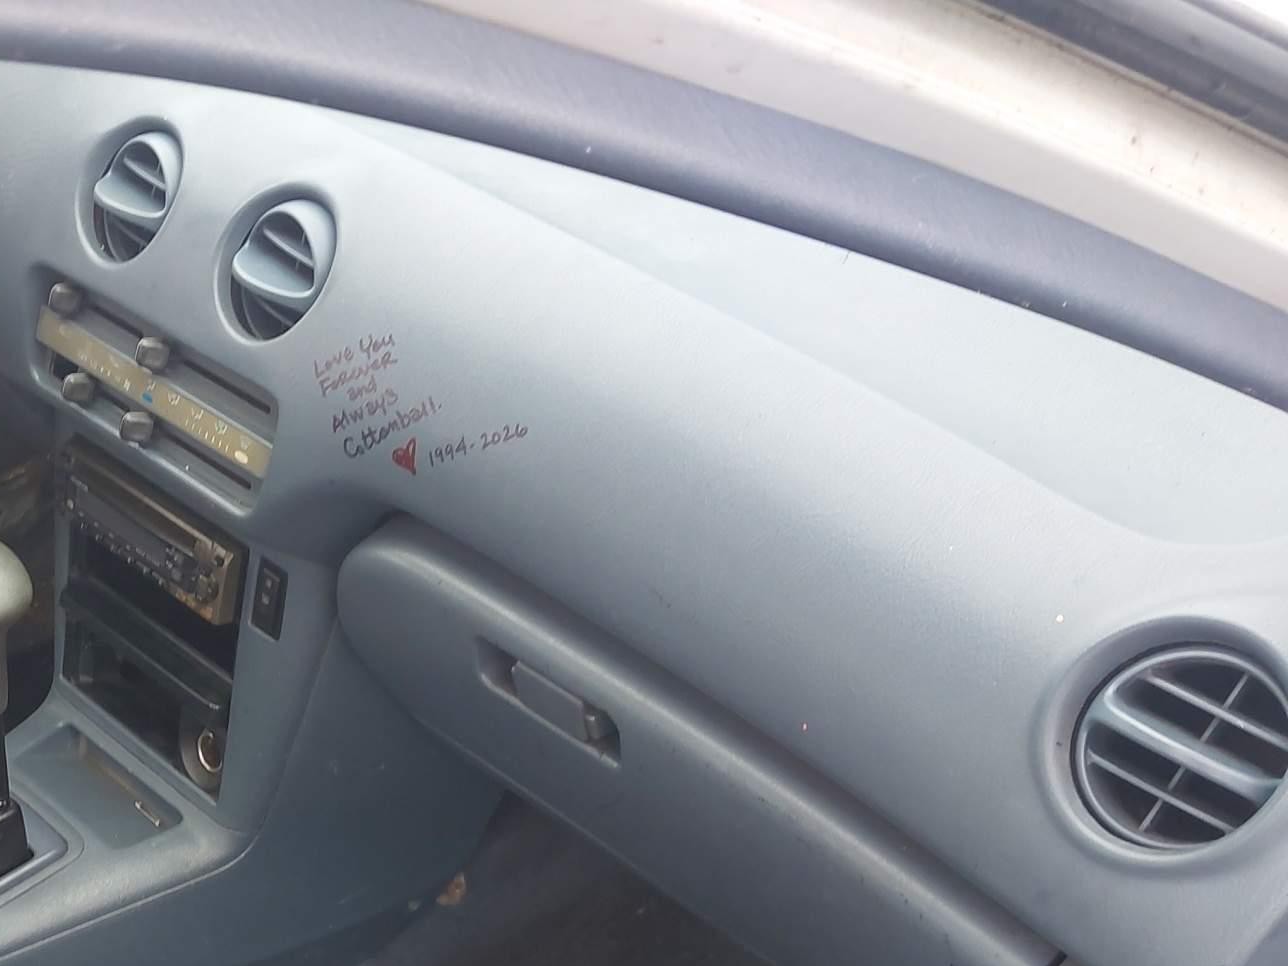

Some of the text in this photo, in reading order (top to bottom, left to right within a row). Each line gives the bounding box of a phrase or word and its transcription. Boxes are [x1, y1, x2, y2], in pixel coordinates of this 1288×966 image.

[313, 333, 396, 379] Love You
[332, 388, 398, 433] Always
[346, 375, 378, 401] and
